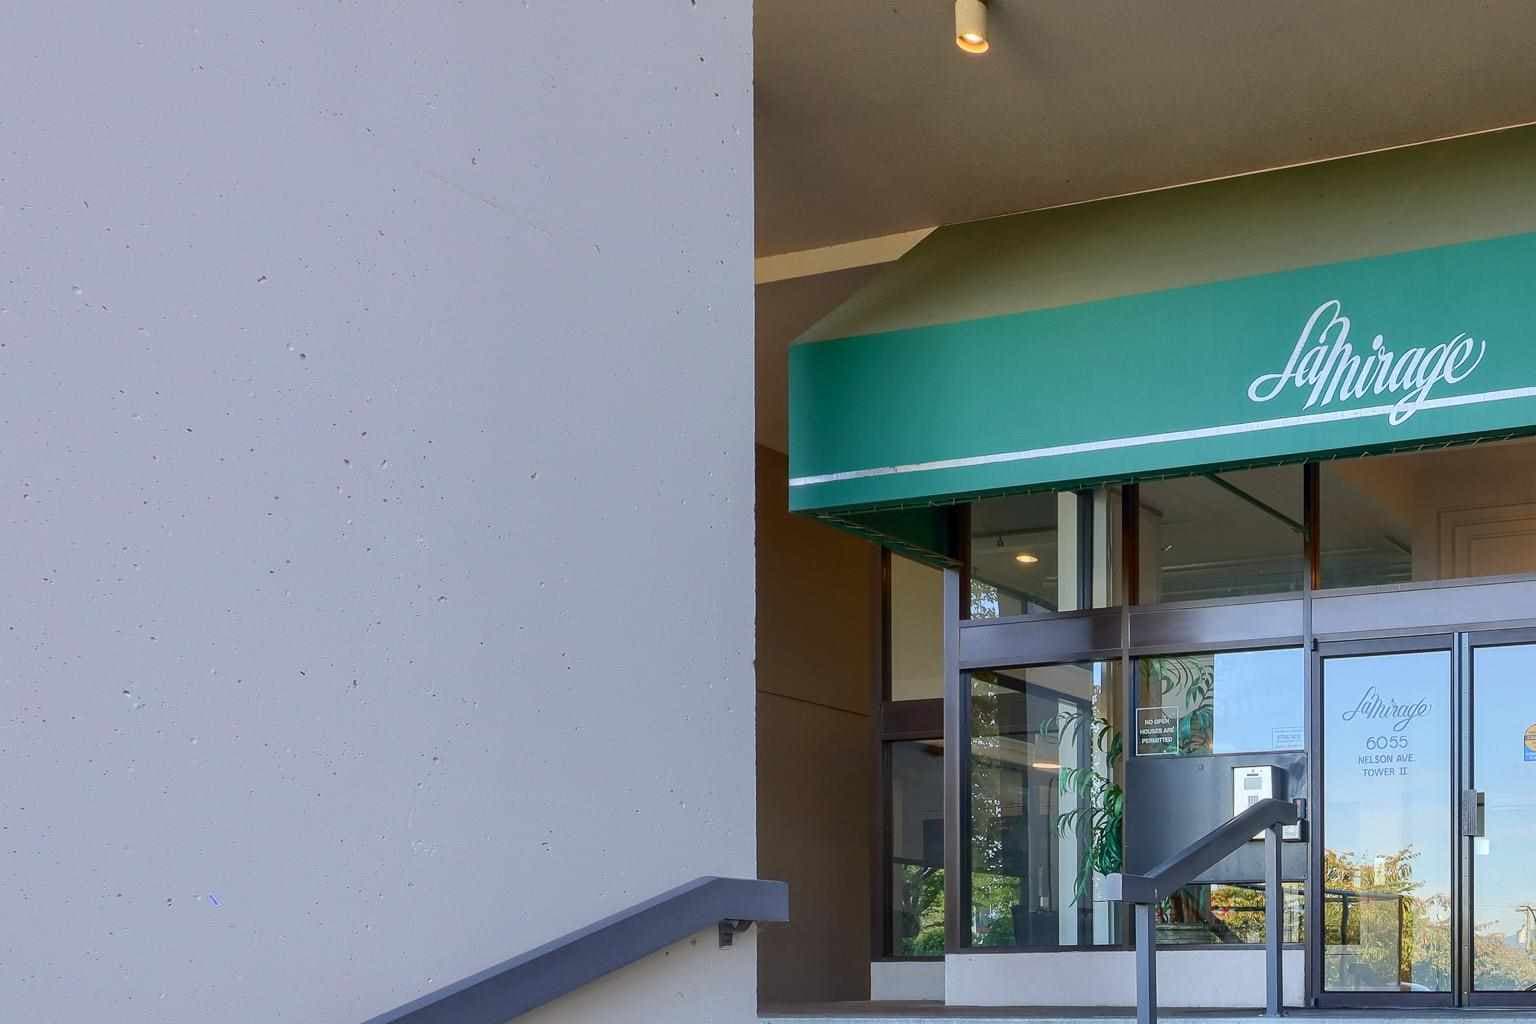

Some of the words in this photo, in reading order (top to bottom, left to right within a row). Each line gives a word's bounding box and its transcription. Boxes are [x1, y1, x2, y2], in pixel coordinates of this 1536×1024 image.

[1366, 735, 1409, 750] 6055
[1358, 754, 1393, 764] NELSON
[1363, 768, 1395, 777] TOWER
